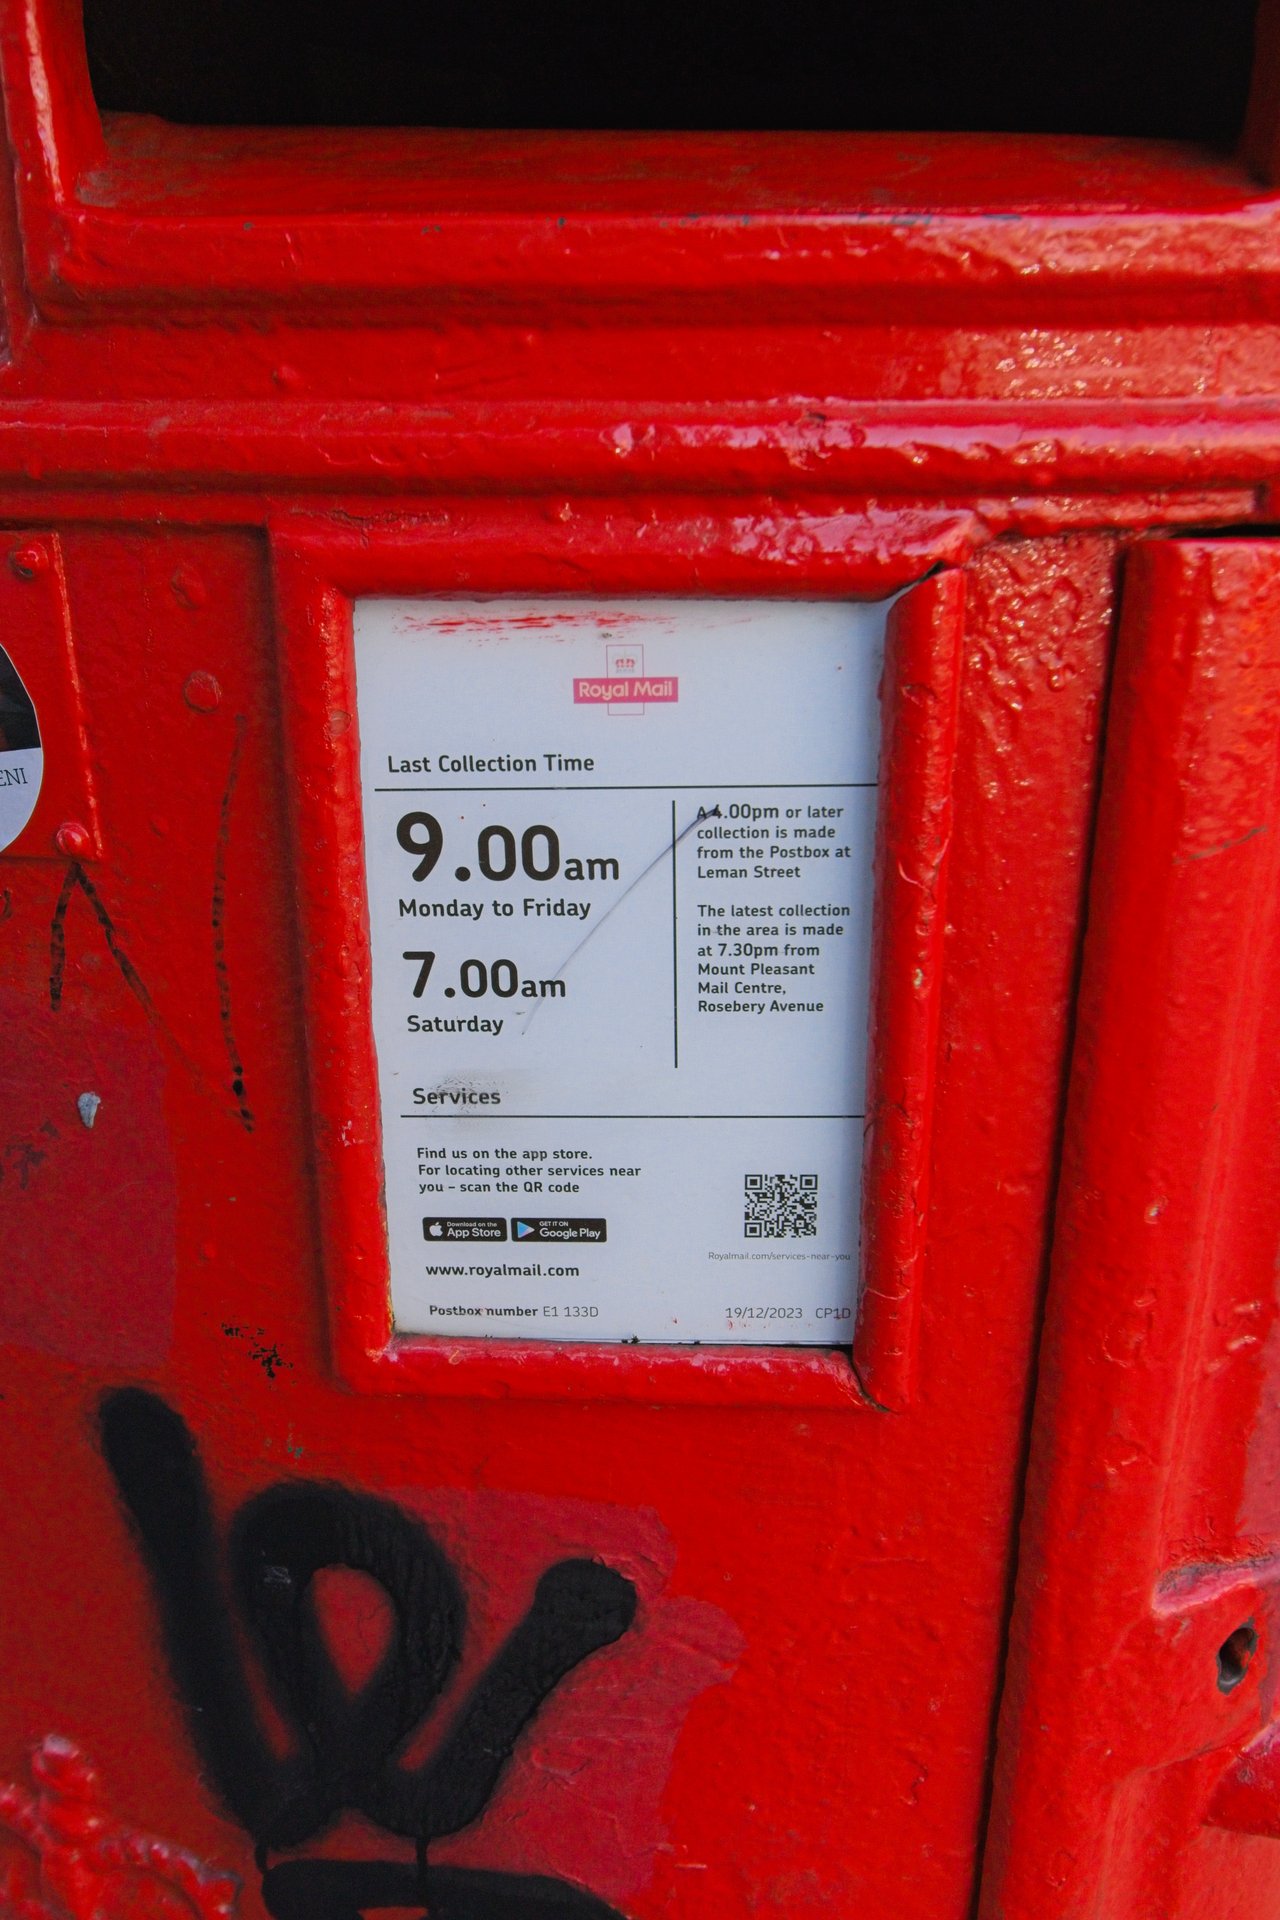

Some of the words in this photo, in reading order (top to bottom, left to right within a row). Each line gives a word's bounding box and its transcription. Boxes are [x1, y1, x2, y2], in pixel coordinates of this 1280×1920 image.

[579, 681, 630, 700] Royal
[634, 681, 673, 696] Mail
[388, 755, 431, 774] Last
[438, 754, 537, 773] Collection
[544, 754, 595, 772] Time
[697, 806, 707, 820] A
[713, 804, 779, 822] 4.00pm
[786, 808, 802, 818] or
[807, 806, 844, 818] later
[697, 826, 769, 839] collection
[776, 827, 787, 839] is
[794, 826, 836, 838] made
[396, 811, 619, 882] 9.00am
[697, 846, 733, 859] from
[740, 846, 764, 858] the
[770, 846, 829, 858] Postbox
[835, 846, 852, 858] at
[698, 866, 747, 878] Leman
[754, 866, 801, 878] Street
[399, 899, 484, 920] Monday
[492, 901, 514, 916] to
[523, 898, 591, 920] Friday
[697, 905, 725, 917] The
[731, 904, 773, 917] latest
[779, 904, 850, 917] collection
[697, 924, 711, 936] in
[717, 924, 740, 936] the
[746, 926, 779, 936] area
[785, 923, 796, 935] is
[803, 923, 844, 935] made
[697, 945, 712, 956] at
[718, 943, 778, 959] 7.30pm
[784, 944, 820, 956] from
[402, 951, 566, 998] 7.00am
[698, 963, 745, 975] Mount
[751, 963, 815, 975] Pleasant
[698, 982, 729, 994] Mail
[734, 982, 786, 995] Centre,
[698, 1000, 765, 1014] Rosebery
[770, 1000, 824, 1012] Avenue
[407, 1015, 504, 1036] Saturday
[412, 1088, 501, 1105] Services
[417, 1148, 446, 1159] Find
[452, 1150, 467, 1159] us
[473, 1150, 489, 1159] on
[495, 1149, 517, 1159] the
[522, 1150, 548, 1161] app
[552, 1150, 592, 1159] store.
[418, 1165, 441, 1176] For
[445, 1165, 500, 1178] locating
[505, 1166, 543, 1176] other
[547, 1166, 604, 1176] services
[609, 1167, 641, 1176] near
[419, 1184, 443, 1194] you
[460, 1184, 490, 1192] scan
[496, 1182, 518, 1193] the
[523, 1182, 543, 1193] QR
[548, 1183, 580, 1193] code
[447, 1228, 470, 1238] App
[472, 1228, 501, 1237] Store
[539, 1228, 577, 1240] Google
[579, 1229, 601, 1240] Play
[708, 1252, 850, 1262] Royalmail.com/services-near-you
[426, 1264, 580, 1278] www.royalmail.com
[430, 1305, 482, 1316] Postbox
[486, 1307, 538, 1317] number
[543, 1306, 563, 1317] E1
[564, 1306, 599, 1317] 133D
[725, 1307, 803, 1319] 19/12/2023
[815, 1308, 851, 1319] CP1D
